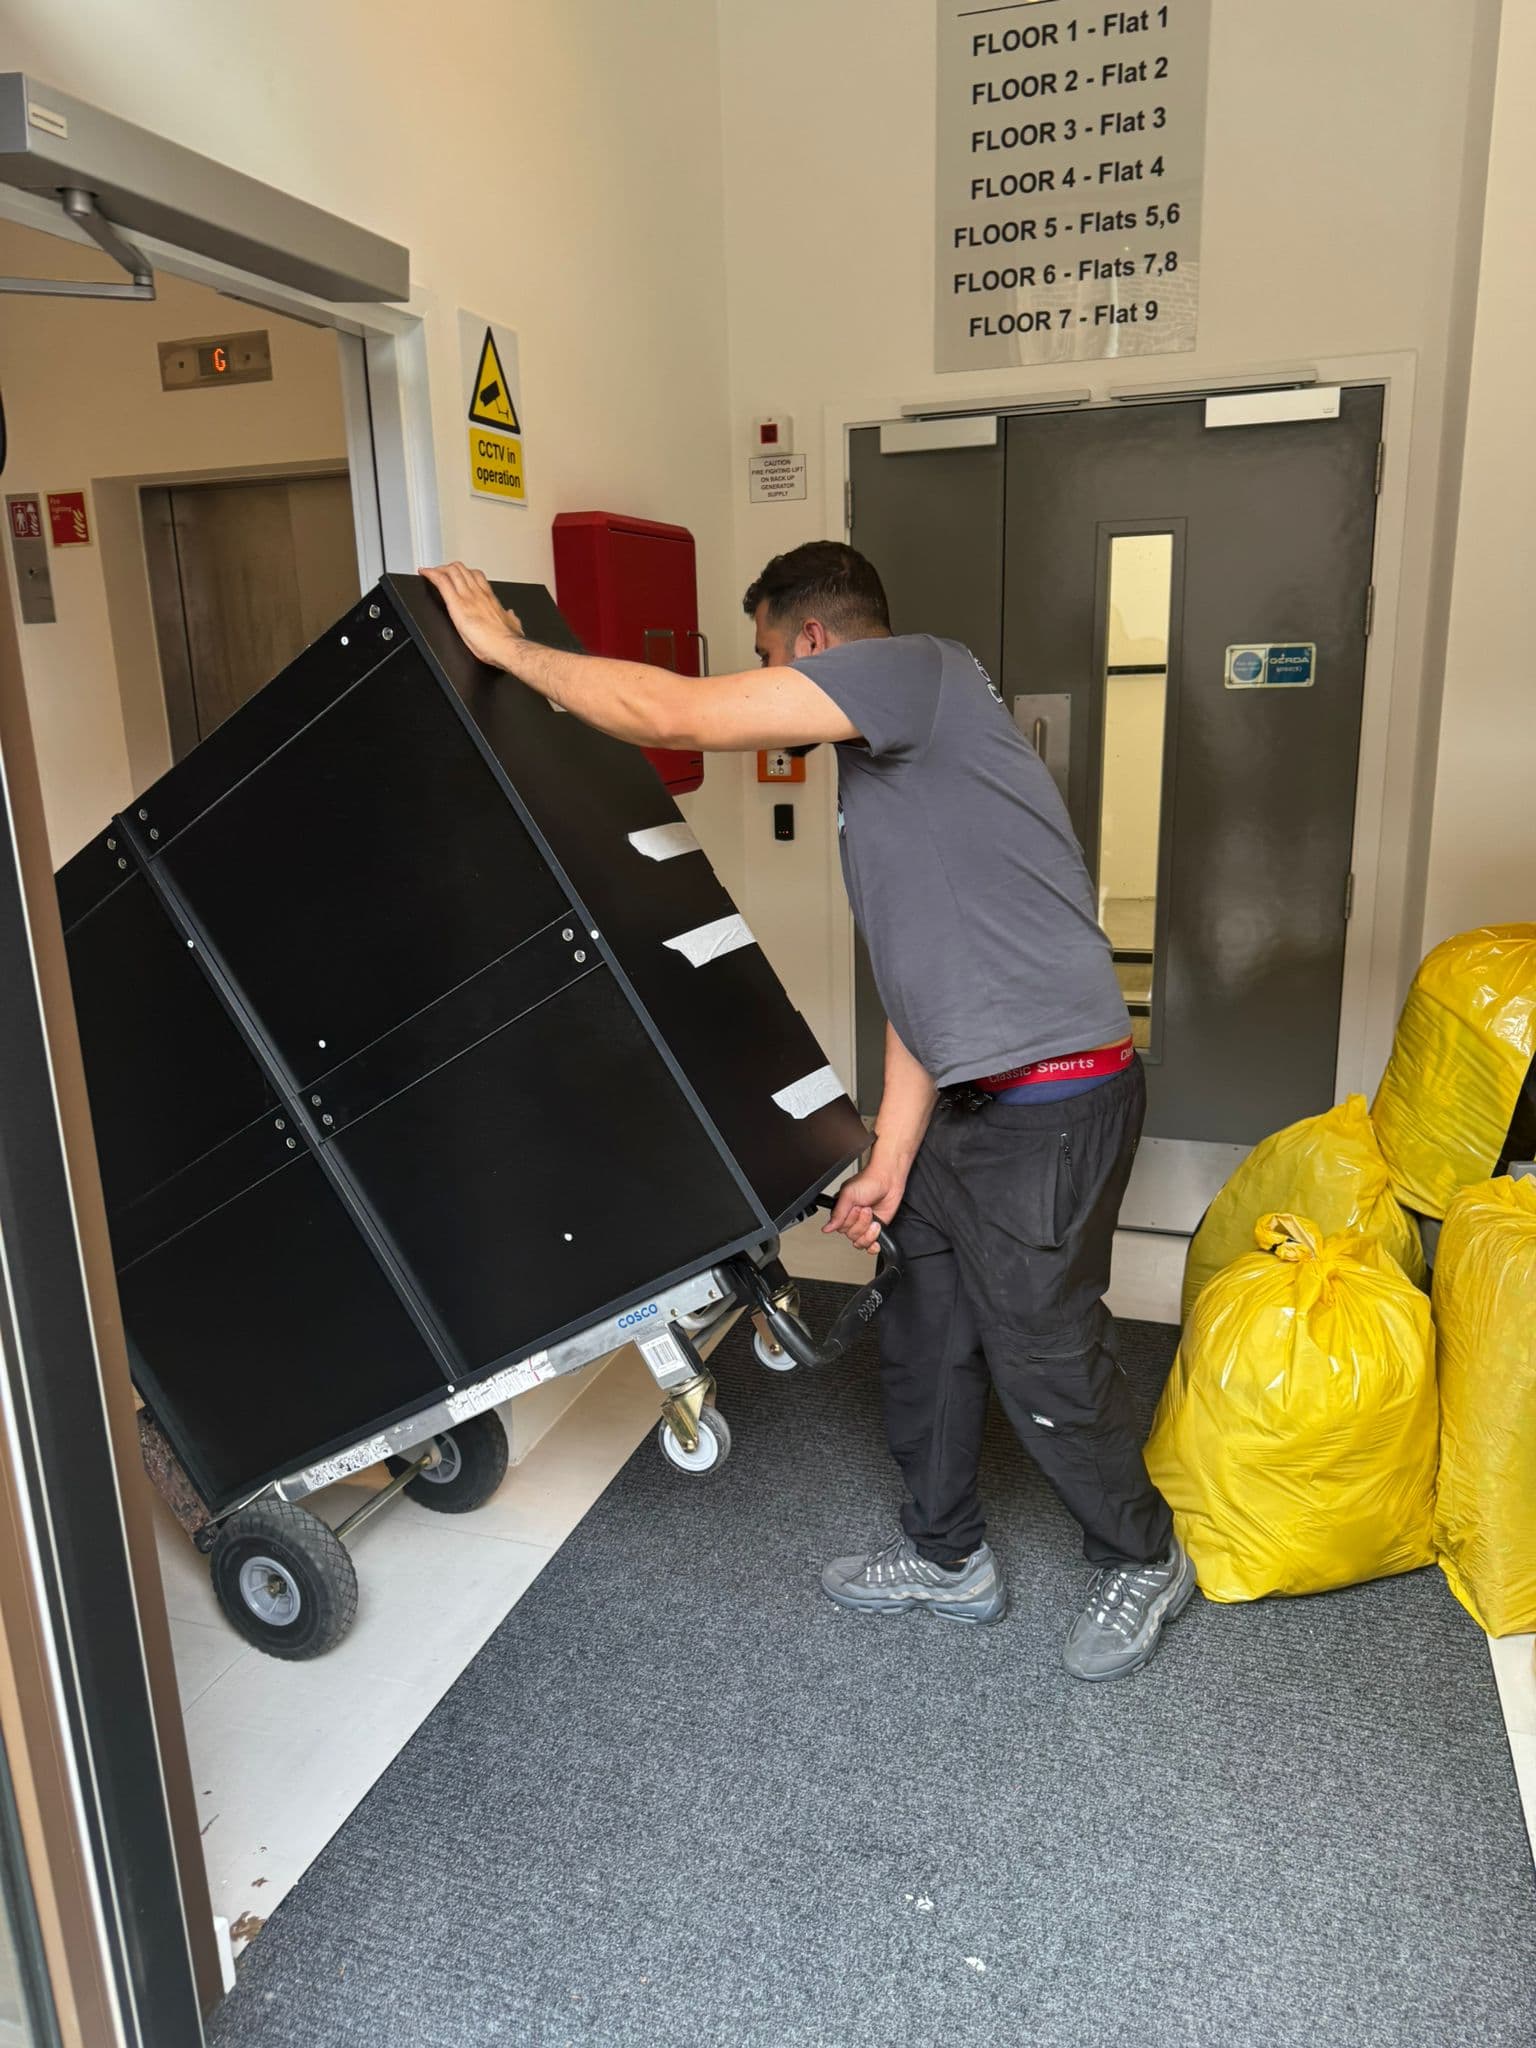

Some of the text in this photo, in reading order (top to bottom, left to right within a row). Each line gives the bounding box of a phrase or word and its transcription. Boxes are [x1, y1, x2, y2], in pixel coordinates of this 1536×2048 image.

[972, 24, 1059, 57] FLOOR
[1066, 20, 1078, 42] 1
[1103, 11, 1149, 37] Flat
[1157, 5, 1169, 29] 1
[972, 73, 1058, 106] FLOOR
[1063, 69, 1079, 93] 2
[1101, 60, 1148, 87] Flat
[1153, 56, 1169, 80] 2
[971, 122, 1057, 153] FLOOR
[1063, 118, 1077, 141] 3
[1100, 110, 1146, 137] Flat
[1152, 106, 1167, 129] 3
[971, 170, 1056, 201] FLOOR
[1061, 166, 1077, 189] 4
[1098, 159, 1144, 185] Flat
[1149, 155, 1165, 178] 4
[954, 219, 1038, 249] FLOOR
[1044, 216, 1058, 239] 5
[1079, 209, 1138, 235] Flats
[1145, 202, 1181, 230] 5,6
[953, 266, 1037, 295] FLOOR
[1042, 263, 1057, 285] 6
[1078, 256, 1136, 282] Flats
[1143, 250, 1178, 278] 7,8
[969, 310, 1052, 338] FLOOR
[1058, 308, 1073, 330] 7
[1094, 302, 1138, 327] Flat
[1144, 299, 1159, 322] 9
[214, 347, 226, 372] G
[478, 439, 516, 465] CCTV in
[764, 459, 791, 467] CAUTION
[476, 466, 520, 488] operation
[760, 482, 795, 490] GENERATOR
[1037, 1058, 1095, 1073] Sports
[617, 1302, 659, 1329] COSCO
